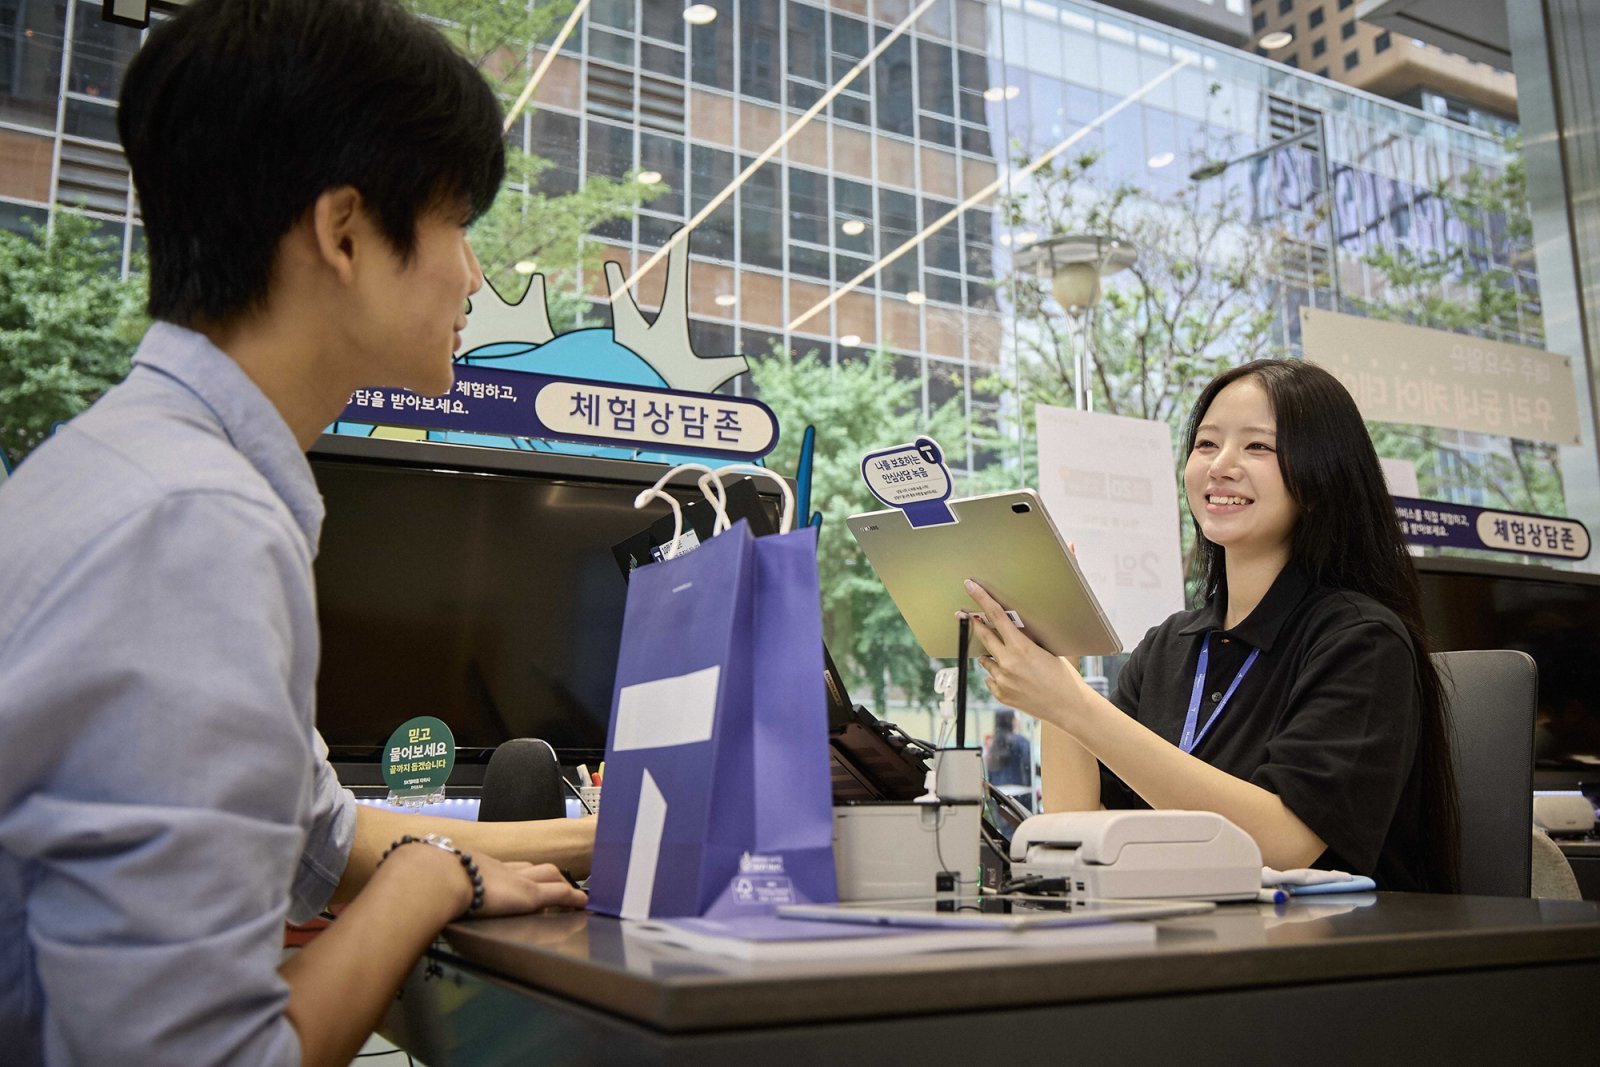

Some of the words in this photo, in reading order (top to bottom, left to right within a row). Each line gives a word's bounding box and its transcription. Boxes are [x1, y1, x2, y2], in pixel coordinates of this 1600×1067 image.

[456, 380, 518, 402] 체험하고,
[390, 393, 470, 415] 받아보세요.
[569, 391, 742, 443] 체험상담존
[875, 460, 891, 471] 나를
[890, 455, 921, 468] 보호하는
[882, 470, 912, 484] 안심상담
[912, 467, 928, 478] 녹음
[1493, 518, 1576, 551] 체험상담존
[409, 728, 431, 743] 믿고
[389, 742, 447, 762] 물어보세요
[389, 763, 410, 775] 끝까지
[411, 759, 447, 771] 돕겠습니다
